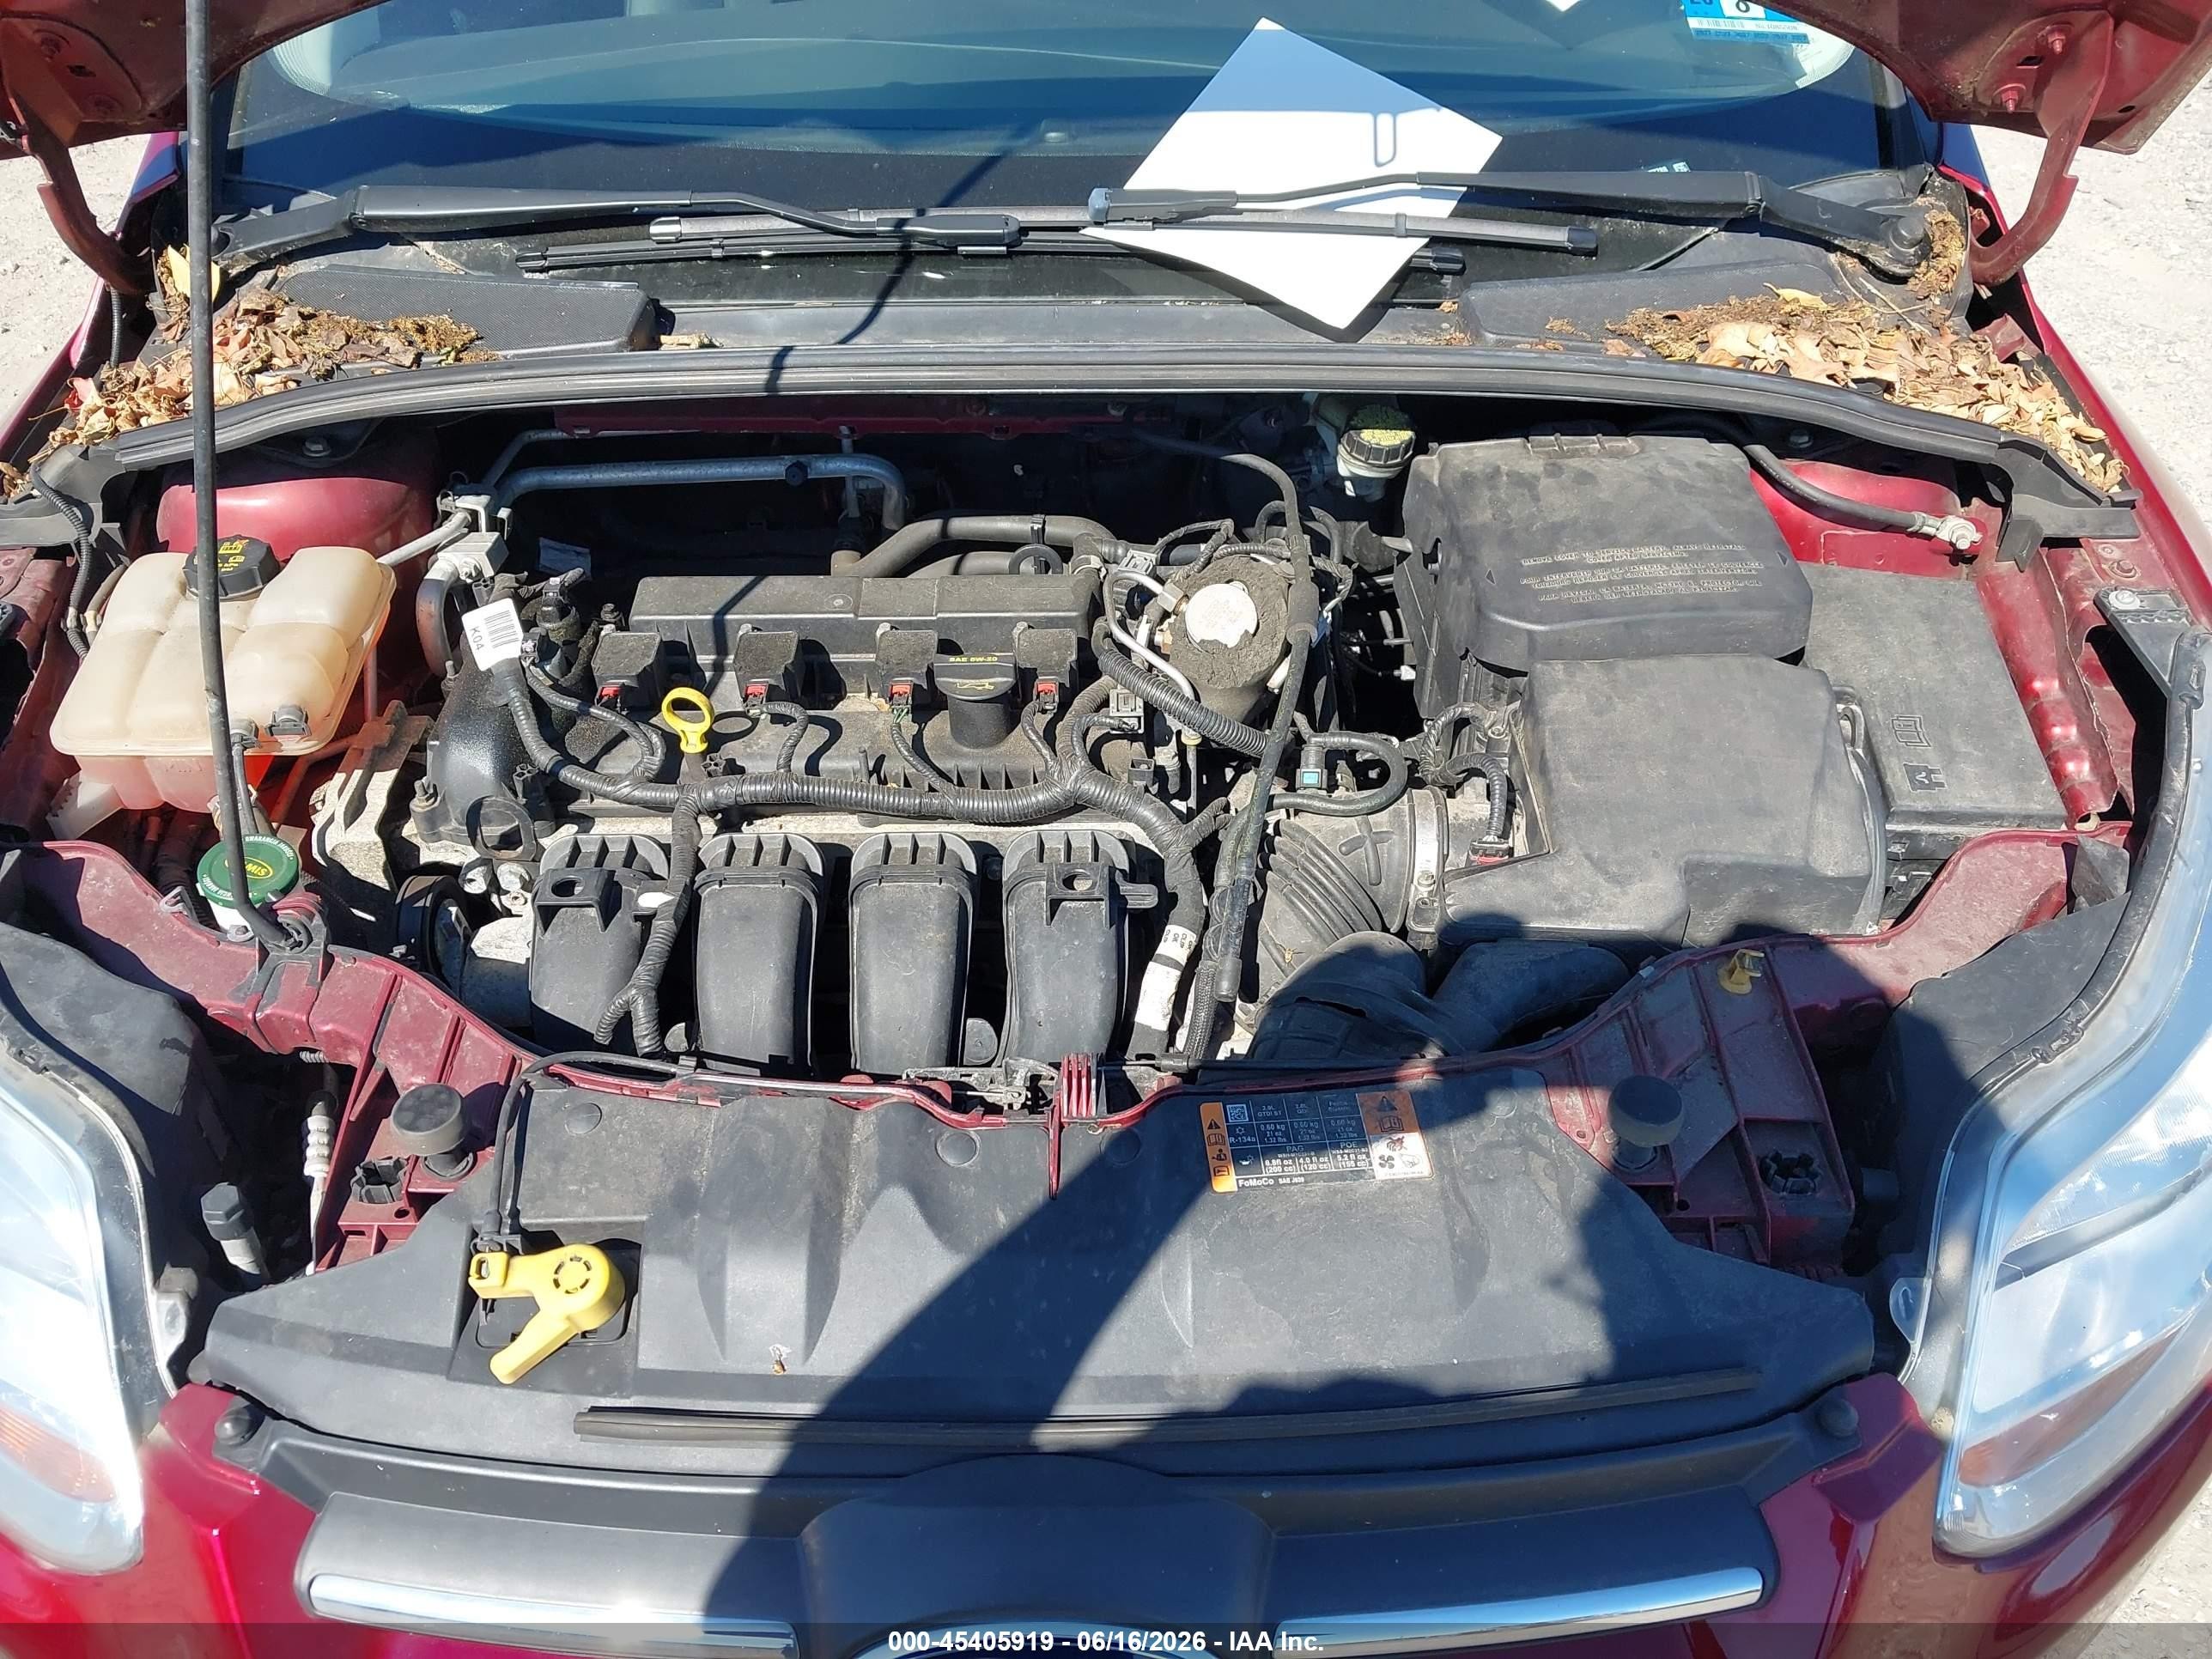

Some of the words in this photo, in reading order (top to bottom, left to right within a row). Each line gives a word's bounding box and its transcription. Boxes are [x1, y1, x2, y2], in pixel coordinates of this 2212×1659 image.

[1554, 552, 1579, 562] COVER
[470, 626, 484, 650] K04
[1276, 1123, 1285, 1132] kg
[1238, 1178, 1274, 1188] FoMoCo
